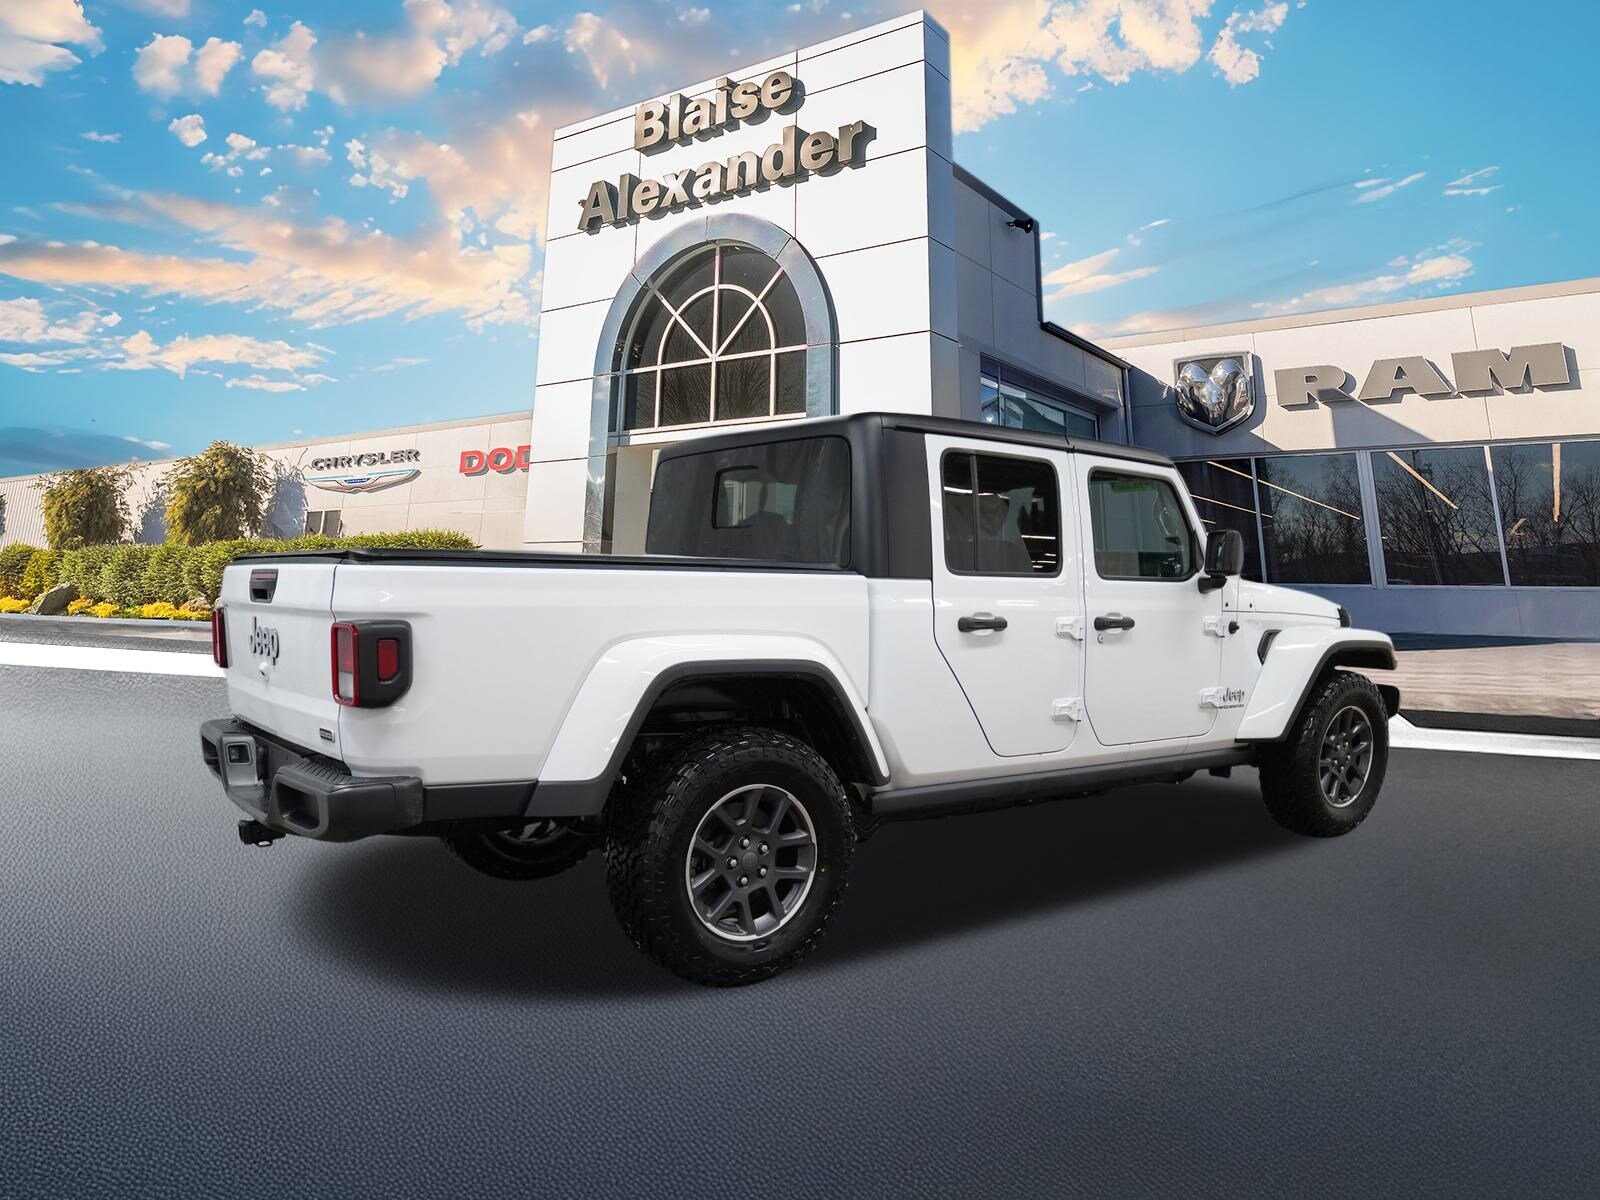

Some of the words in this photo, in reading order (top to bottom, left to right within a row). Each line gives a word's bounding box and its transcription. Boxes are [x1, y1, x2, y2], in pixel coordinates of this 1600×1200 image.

[634, 71, 804, 157] Blaise
[577, 120, 877, 235] Alexander
[1274, 342, 1577, 411] RAM
[311, 448, 420, 471] CHRYSLER
[249, 616, 280, 666] Jeep
